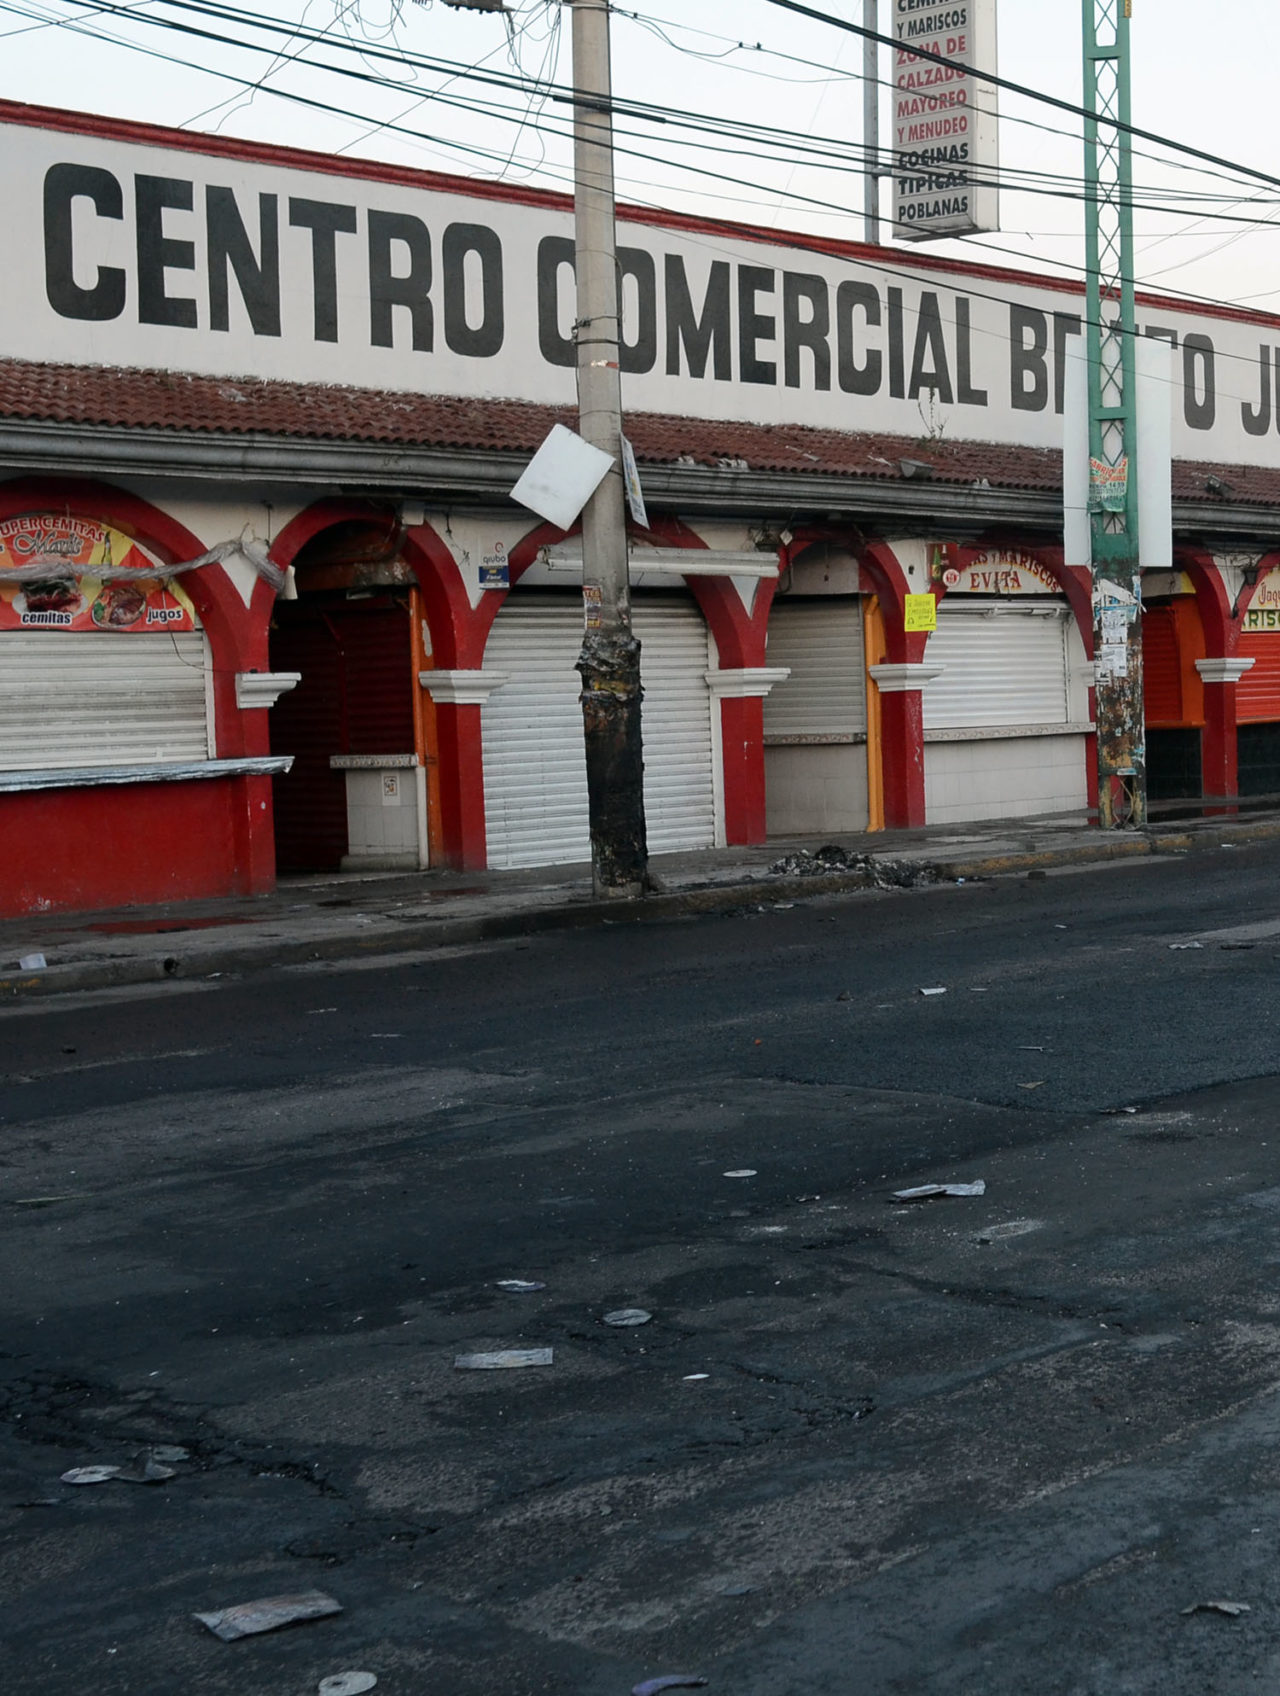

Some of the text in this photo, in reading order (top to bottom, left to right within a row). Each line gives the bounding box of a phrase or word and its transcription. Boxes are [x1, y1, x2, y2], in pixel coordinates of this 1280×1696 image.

[897, 8, 967, 38] Y MARISCOS
[946, 35, 966, 55] DE
[897, 64, 967, 90] CALZADO
[897, 88, 967, 118] MAYOREO
[897, 115, 968, 144] Y MENUDEO
[899, 142, 969, 171] COCINAS
[898, 170, 969, 195] TIPICAS
[898, 196, 969, 222] POBLANAS
[43, 162, 504, 358] CENTRO
[0, 516, 105, 543] UPER CEMITAS
[969, 570, 1022, 591] EVITA
[22, 611, 73, 626] cemitas
[147, 607, 183, 624] jugos
